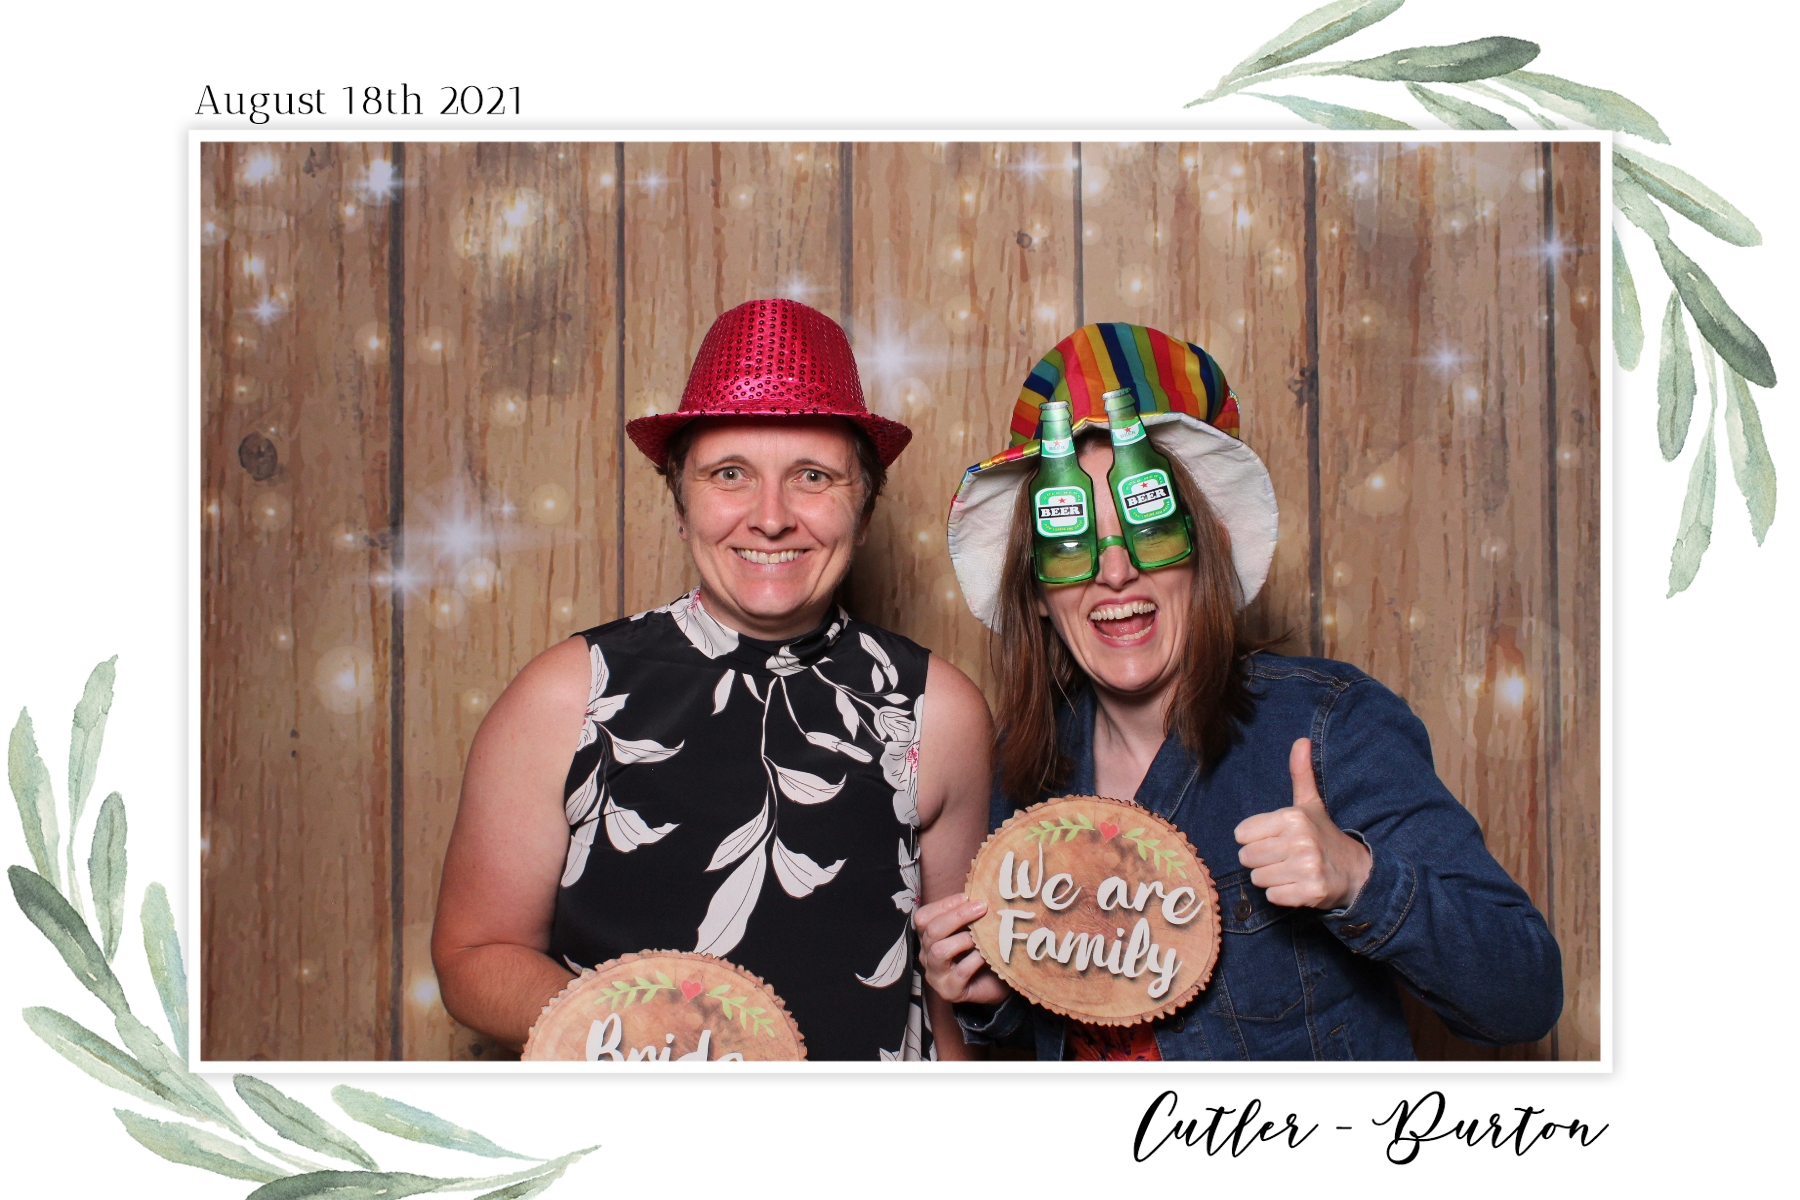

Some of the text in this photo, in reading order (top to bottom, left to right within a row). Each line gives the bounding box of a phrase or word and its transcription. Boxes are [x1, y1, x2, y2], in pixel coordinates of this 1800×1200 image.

[1040, 506, 1081, 518] BEER
[1126, 488, 1167, 507] BEER
[998, 841, 1204, 925] We are
[997, 908, 1183, 999] Family
